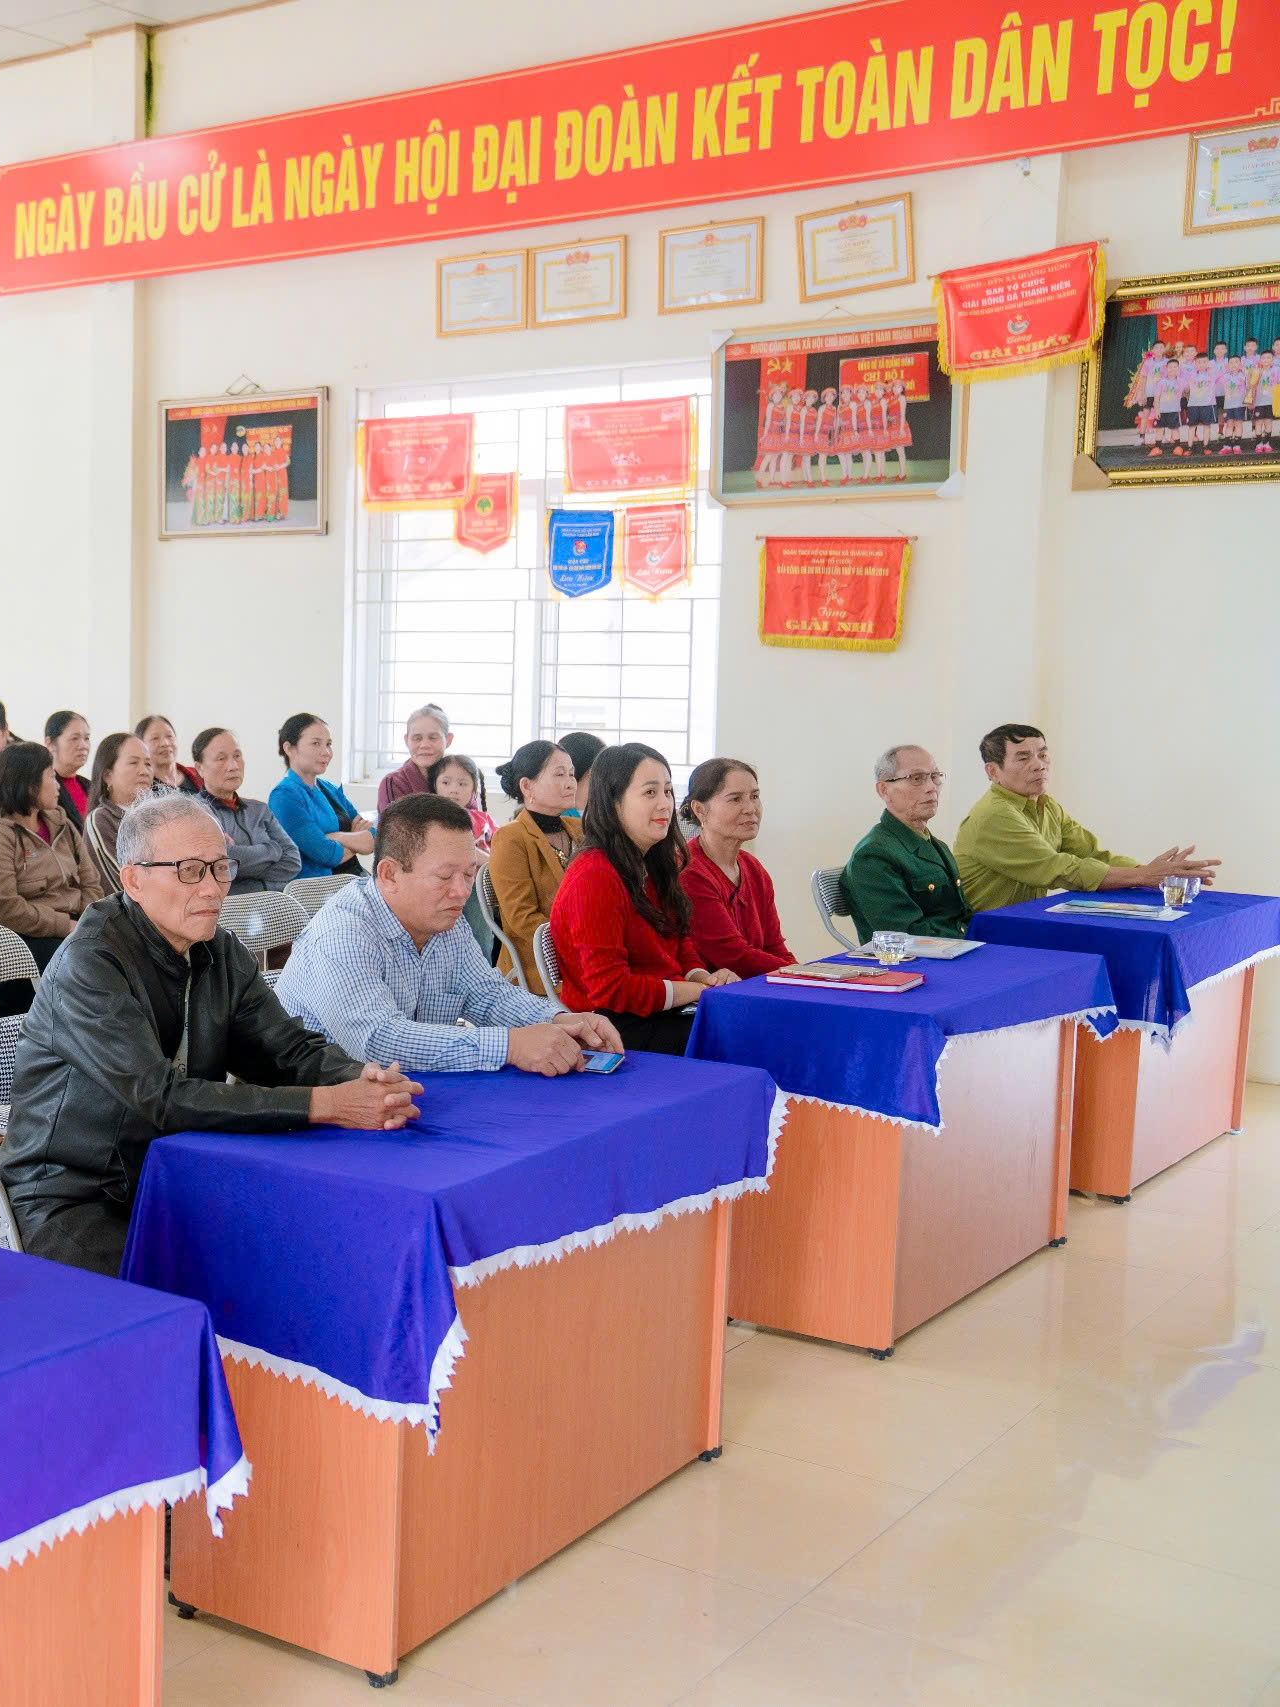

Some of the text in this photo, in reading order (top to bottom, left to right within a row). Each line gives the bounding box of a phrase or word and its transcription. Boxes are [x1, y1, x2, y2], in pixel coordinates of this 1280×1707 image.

[15, 0, 1237, 259] NGÀY BẦU CỬ LÀ NGÀY HỘI ĐẠI ĐOÀN KẾT TOÀN DÂN TỘC!
[985, 287, 1005, 296] BAN
[1020, 287, 1049, 300] THANH
[786, 617, 829, 631] GIẢI
